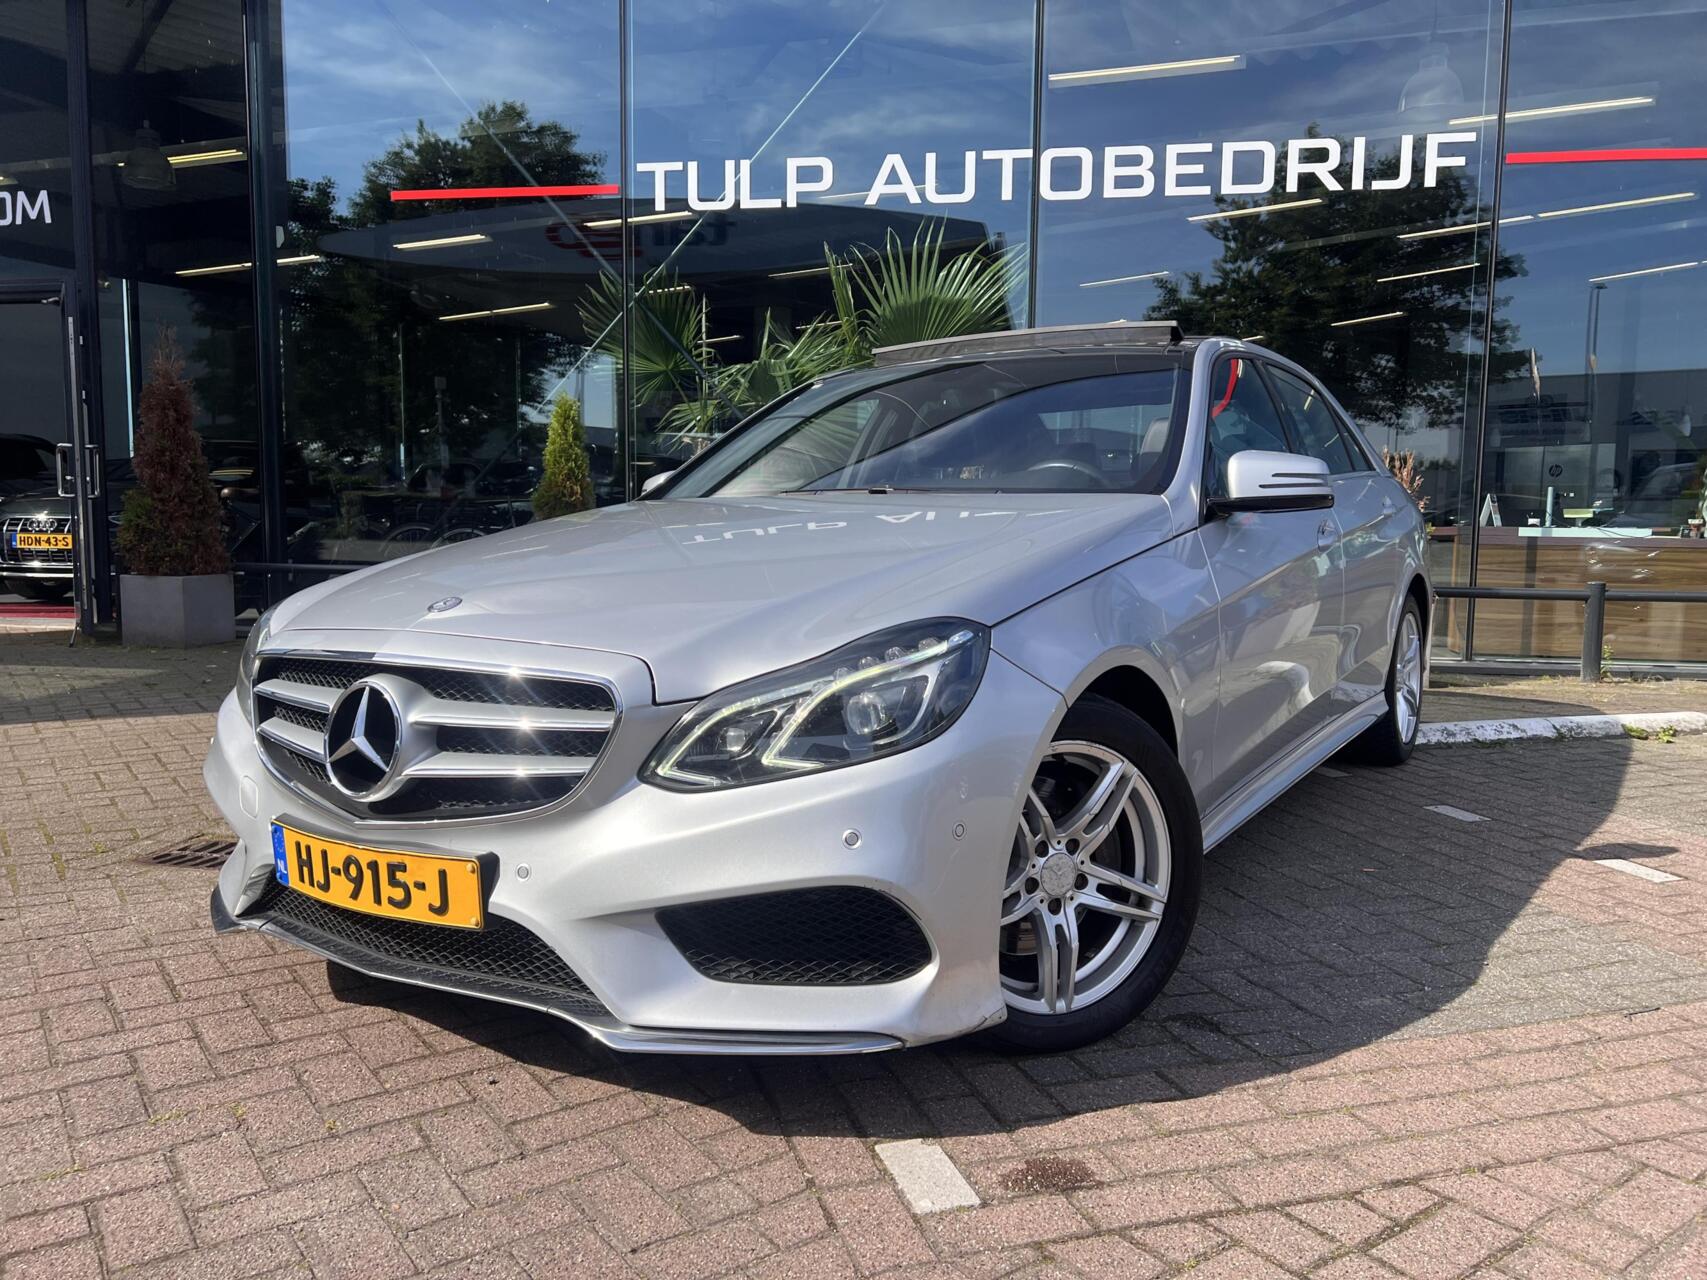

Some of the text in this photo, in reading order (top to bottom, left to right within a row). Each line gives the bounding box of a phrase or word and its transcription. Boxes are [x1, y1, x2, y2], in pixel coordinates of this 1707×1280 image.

[636, 132, 1477, 212] TULP AUTOBEDRIJF
[19, 535, 69, 547] HDN-43-S
[276, 840, 450, 917] NL HJ-915-J
